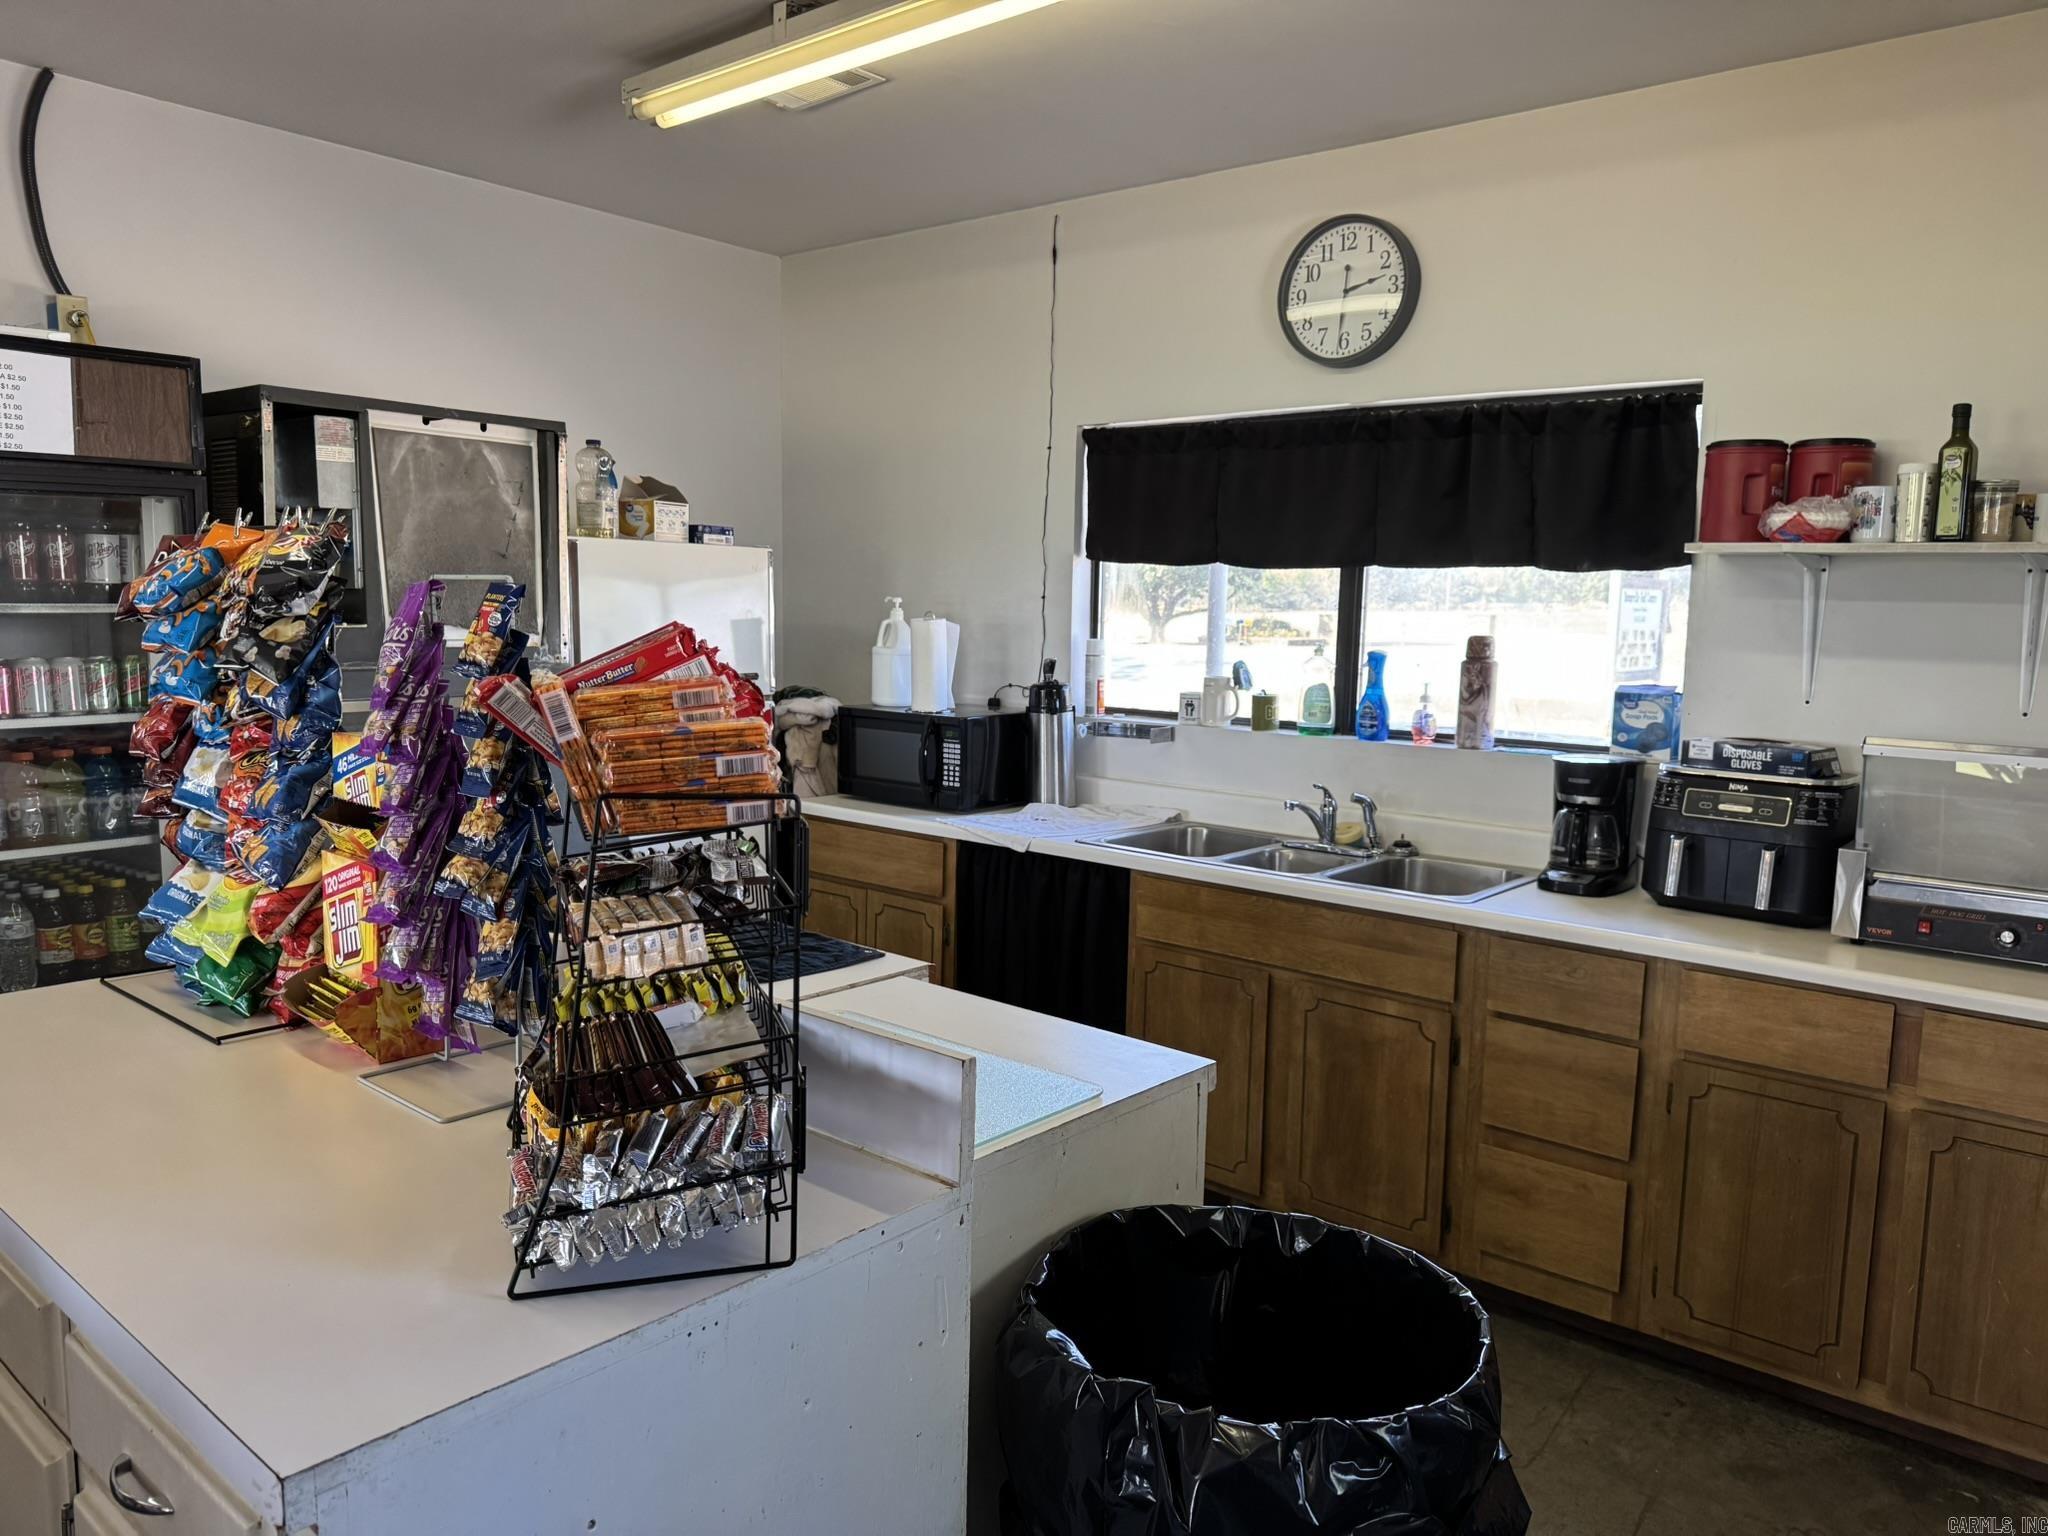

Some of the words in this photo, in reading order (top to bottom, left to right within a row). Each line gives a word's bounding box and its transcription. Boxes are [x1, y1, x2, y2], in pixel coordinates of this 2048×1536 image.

[1339, 232, 1358, 251] 12
[1367, 234, 1374, 253] 1
[1320, 243, 1334, 263] 11
[1380, 250, 1392, 270] 2
[1304, 263, 1321, 283] 10
[1387, 275, 1399, 294] 3
[1296, 289, 1307, 305] 9
[1318, 327, 1329, 346] 7
[1338, 331, 1350, 350] 6
[1361, 322, 1373, 341] 5
[1, 382, 20, 391] $1.50
[7, 373, 27, 382] $2.50
[2, 403, 22, 411] $1.00
[3, 413, 23, 421] $2.50
[4, 422, 24, 431] $2.50
[3, 442, 23, 450] $2.50
[1722, 748, 1772, 762] DISPOSABLE
[1731, 759, 1762, 770] GLOVES
[337, 756, 348, 774] 46
[345, 775, 369, 800] slim
[324, 875, 338, 895] 120
[329, 898, 358, 932] slim
[335, 925, 362, 966] jim
